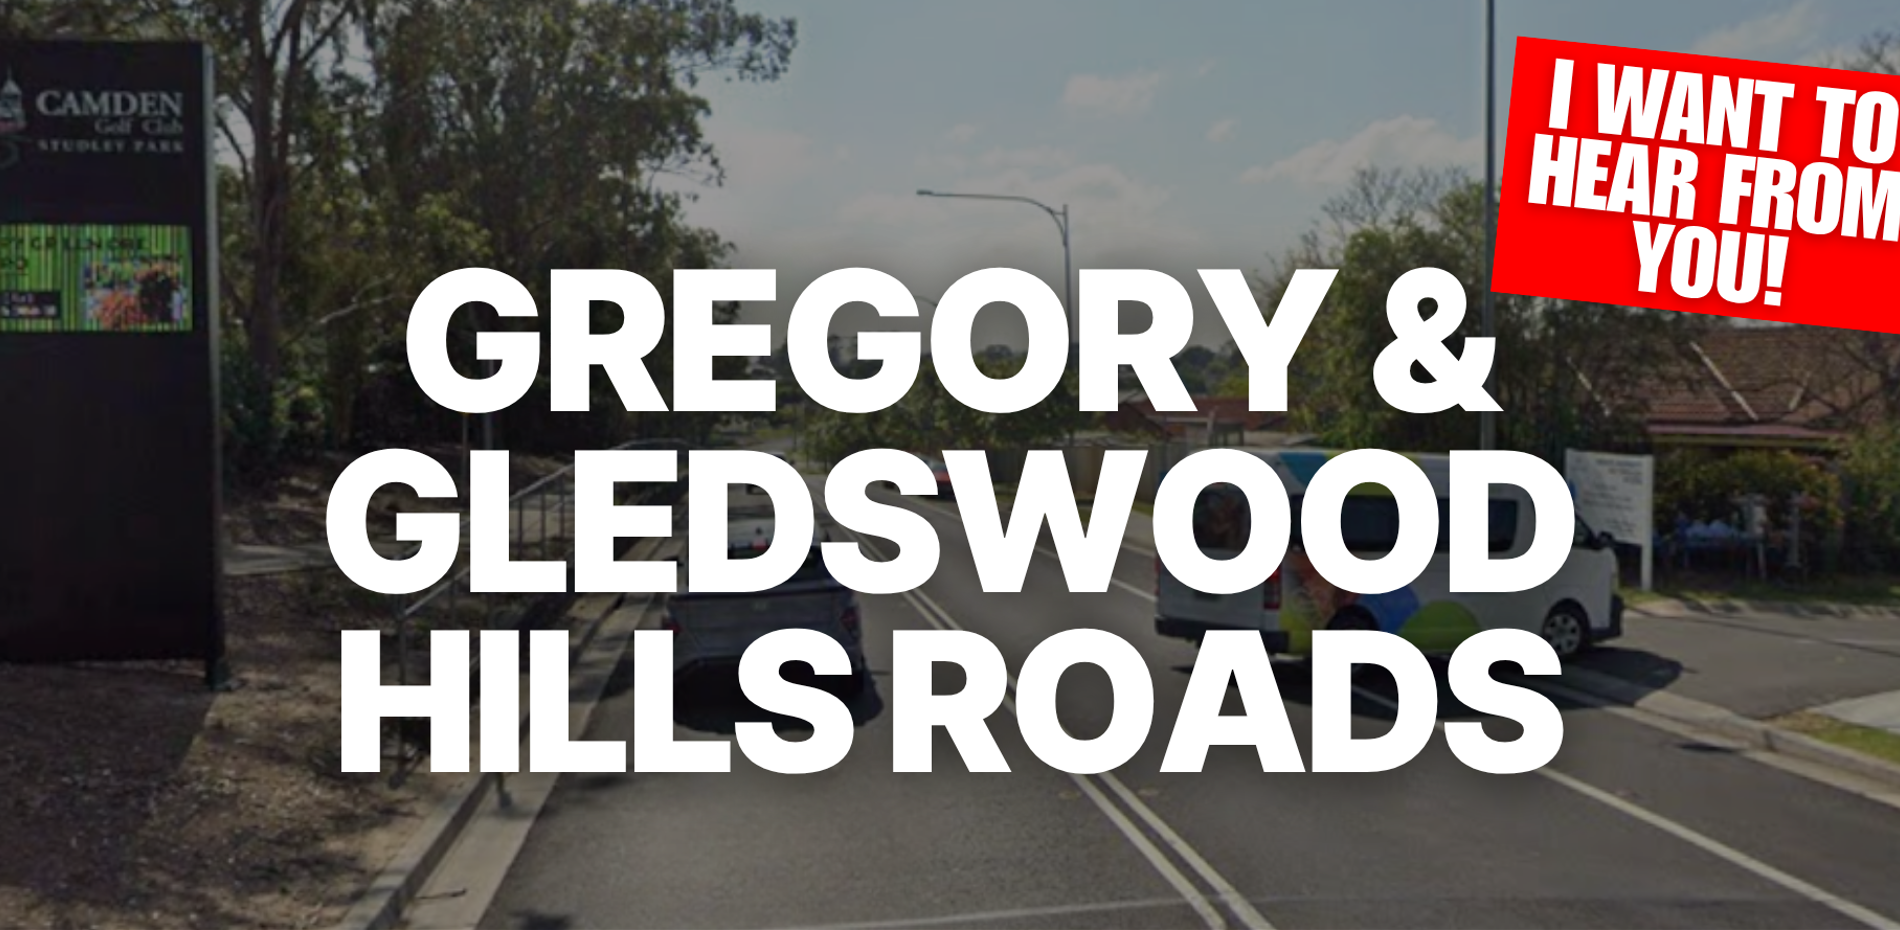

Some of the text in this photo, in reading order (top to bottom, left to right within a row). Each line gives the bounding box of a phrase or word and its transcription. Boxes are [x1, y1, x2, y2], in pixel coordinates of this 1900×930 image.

[36, 90, 184, 117] CAMDEN
[94, 117, 183, 135] Golf Club
[37, 139, 184, 153] STUDLEY PARK
